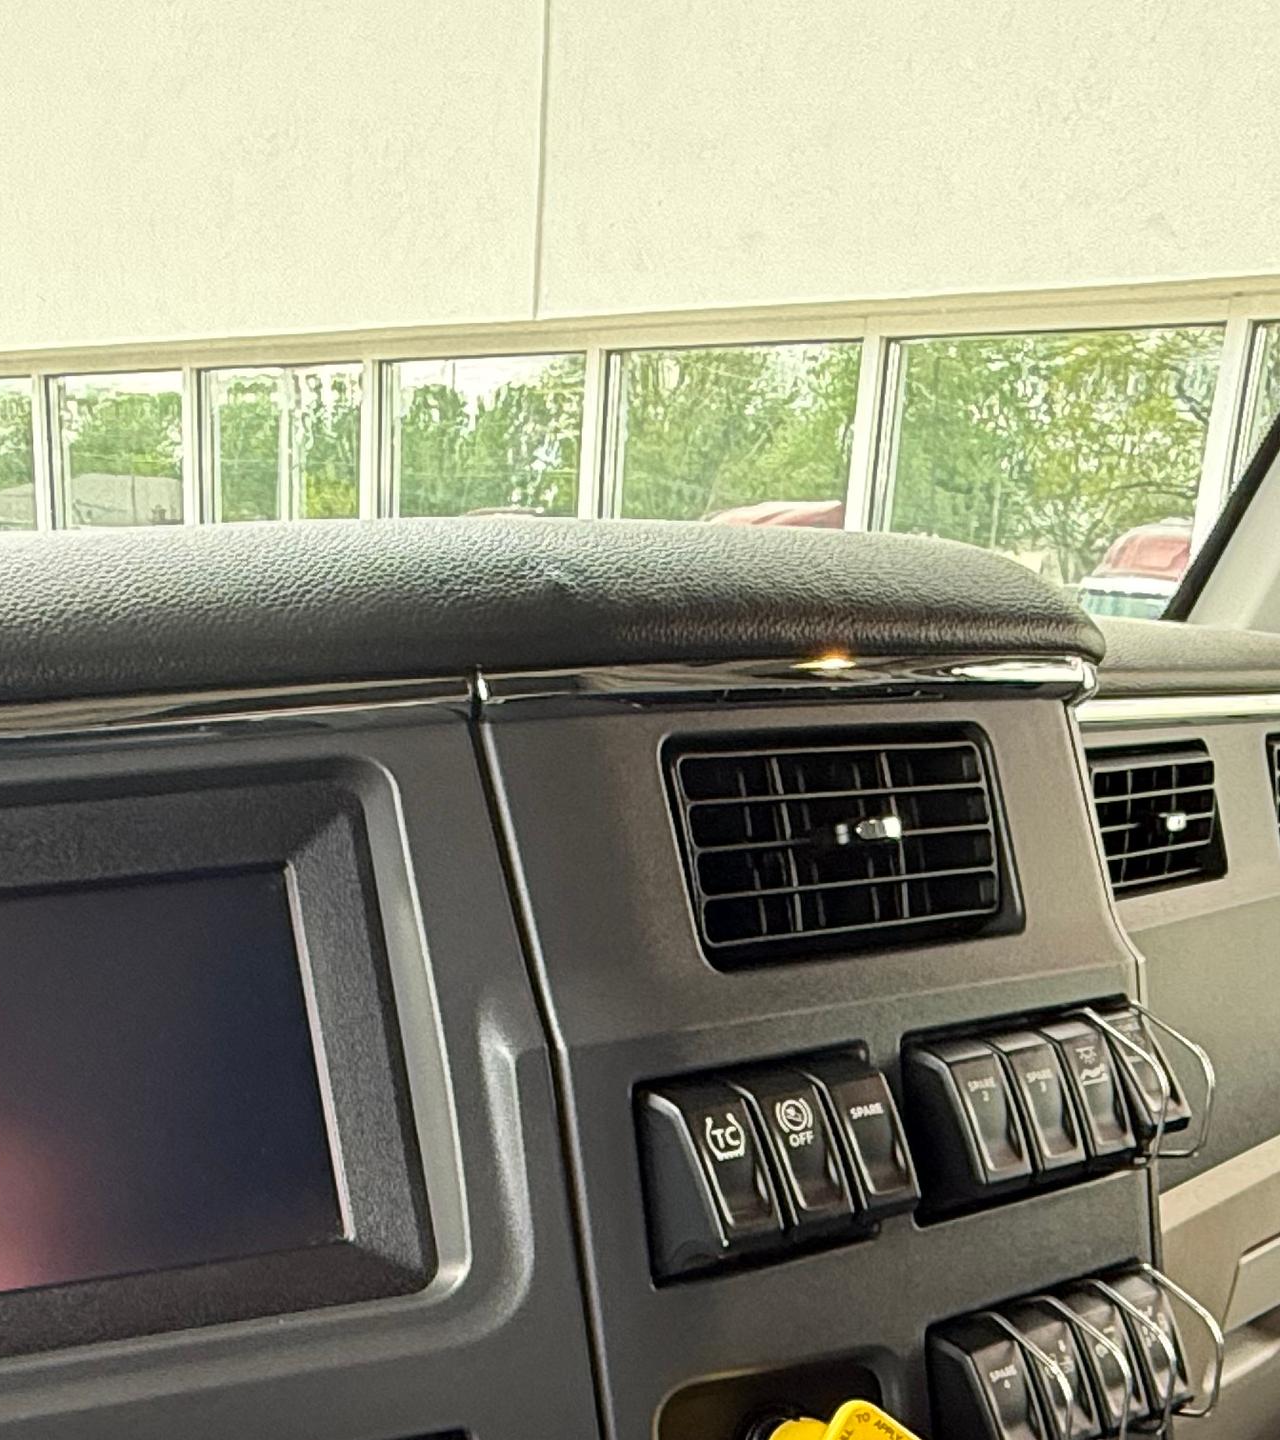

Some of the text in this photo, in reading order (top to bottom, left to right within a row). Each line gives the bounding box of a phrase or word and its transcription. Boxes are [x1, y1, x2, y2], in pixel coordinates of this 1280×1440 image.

[850, 1102, 884, 1120] SPARE
[710, 1126, 741, 1149] TC
[789, 1130, 814, 1148] OFF
[856, 1412, 870, 1424] TO
